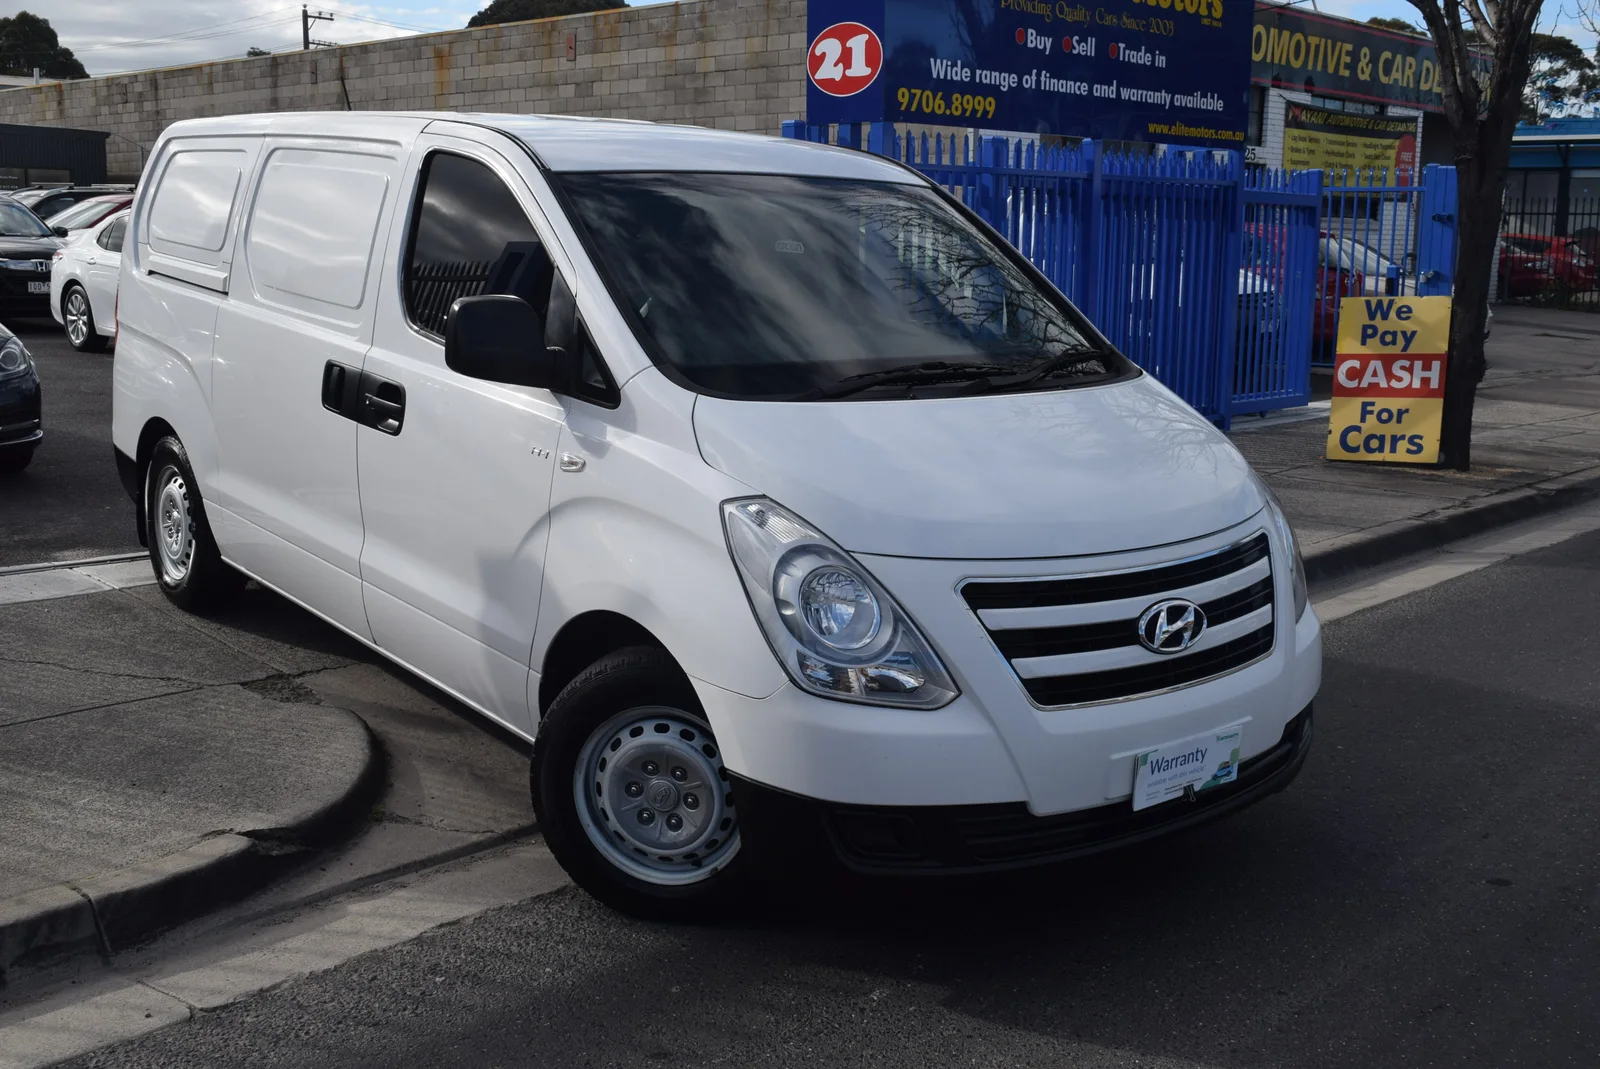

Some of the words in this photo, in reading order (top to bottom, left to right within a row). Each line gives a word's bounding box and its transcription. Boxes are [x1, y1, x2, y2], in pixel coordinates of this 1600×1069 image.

[1056, 1, 1091, 28] Quality
[1095, 7, 1118, 26] Cars
[1120, 11, 1146, 31] Since
[1149, 17, 1174, 36] 2003
[814, 33, 872, 82] 21
[1027, 28, 1052, 55] Buy
[1072, 36, 1095, 57] Sell
[1118, 43, 1152, 66] Trade
[1155, 51, 1166, 68] in
[1357, 47, 1372, 81] &
[1378, 50, 1417, 88] CAR
[930, 57, 971, 82] Wide
[976, 68, 1018, 91] range
[1022, 69, 1037, 89] of
[1040, 70, 1088, 95] finance
[1093, 80, 1116, 99] and
[1120, 87, 1172, 110] warranty
[1174, 91, 1224, 111] available
[897, 87, 996, 119] 9706.8999
[1148, 121, 1245, 141] www.elitemotors.com.au
[1364, 298, 1413, 321] We
[1360, 324, 1418, 353] Pay
[1337, 359, 1441, 389] CASH
[1359, 401, 1410, 425] For
[1339, 425, 1424, 455] Cars
[1150, 747, 1208, 775] Warranty
